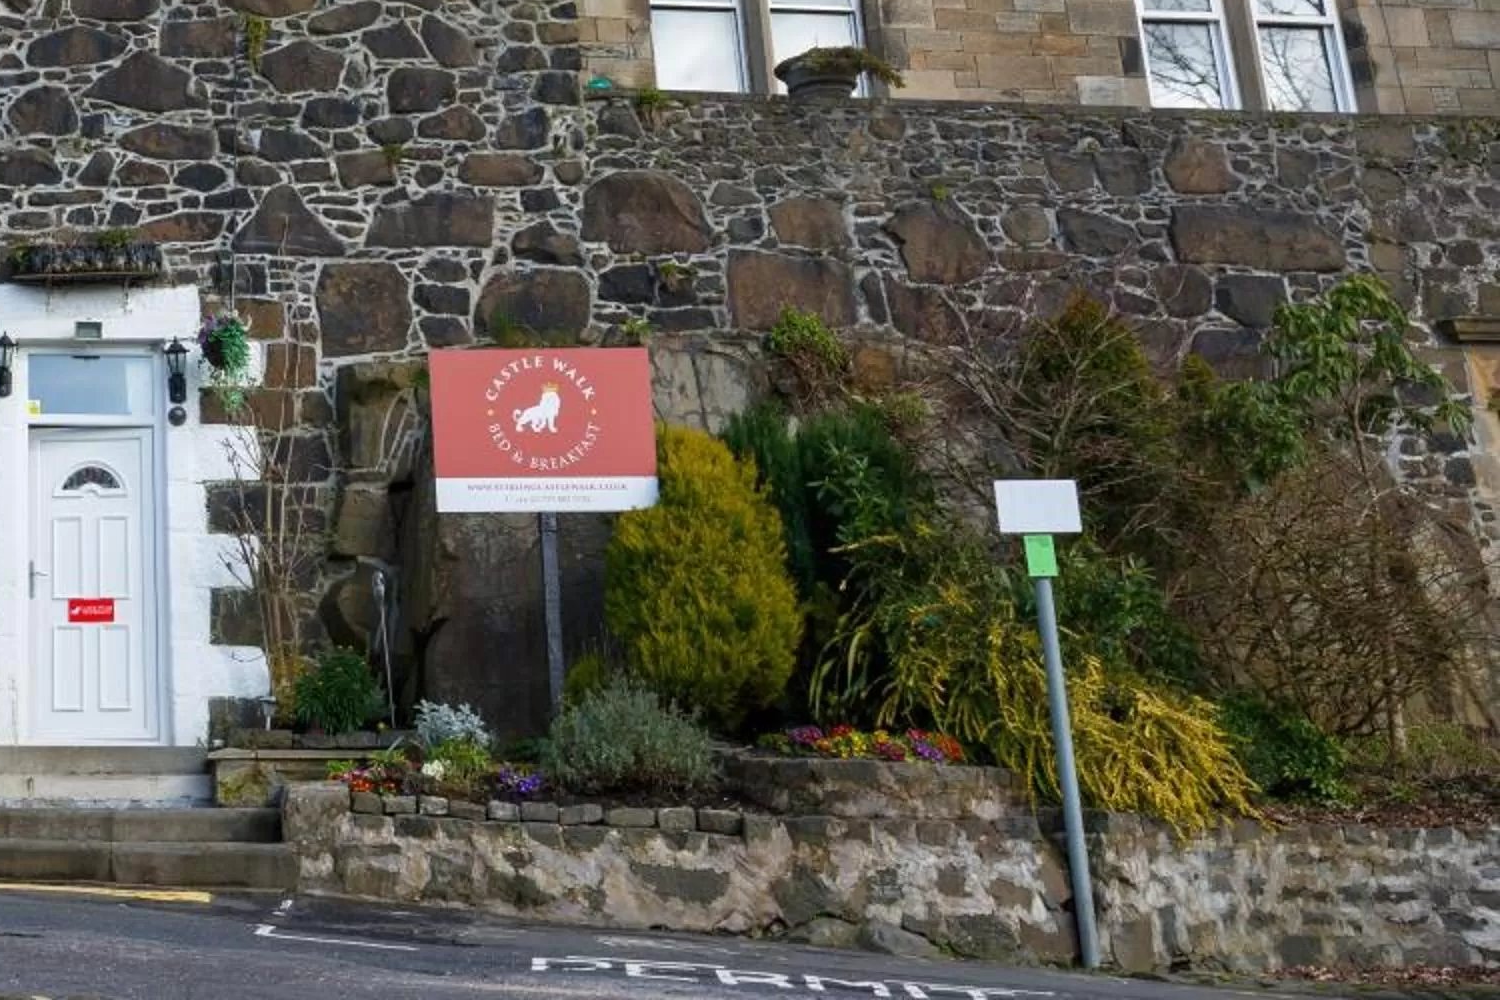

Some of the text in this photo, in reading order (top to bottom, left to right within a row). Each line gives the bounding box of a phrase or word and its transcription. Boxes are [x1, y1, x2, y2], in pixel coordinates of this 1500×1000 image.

[485, 355, 596, 401] CASTLE WALK
[488, 423, 512, 451] BED
[529, 421, 601, 471] BREAKFAST
